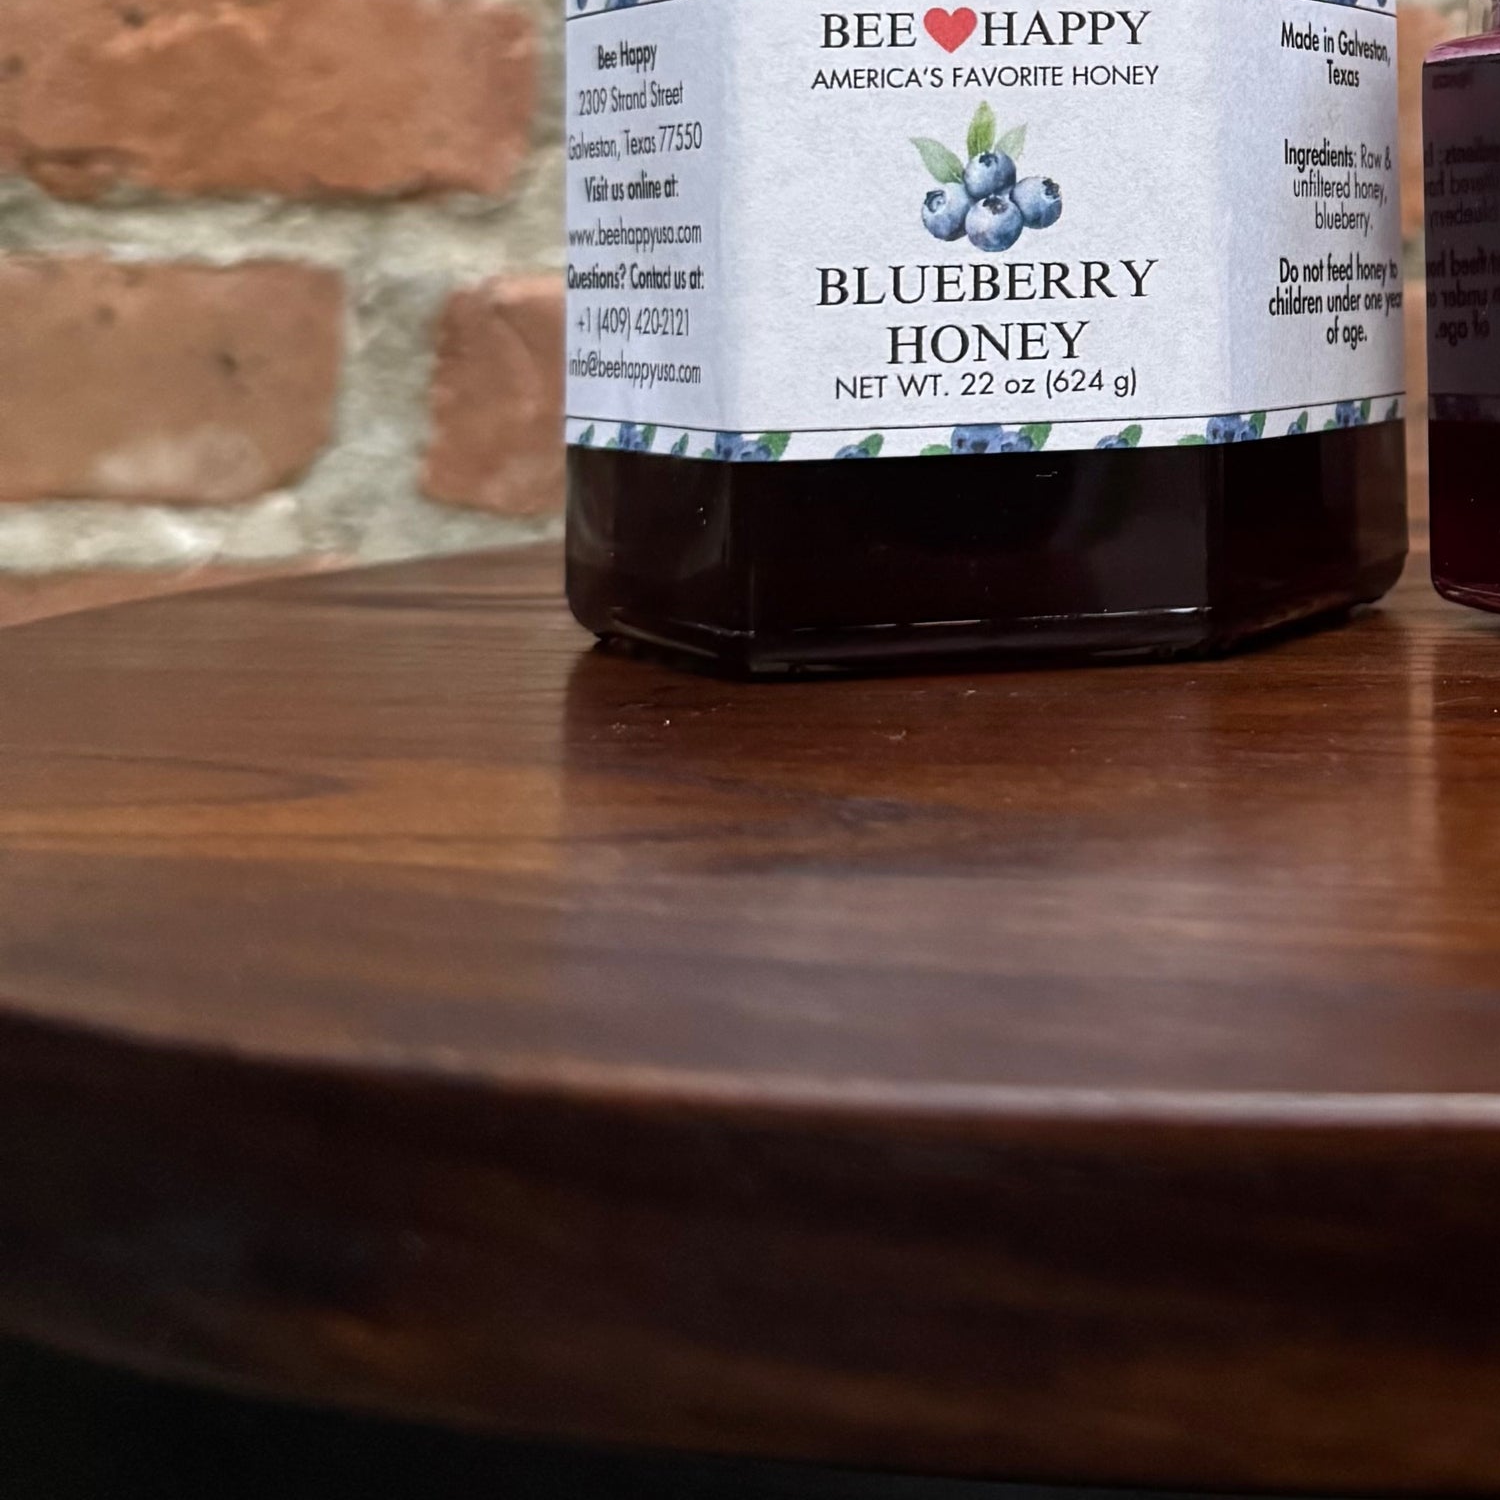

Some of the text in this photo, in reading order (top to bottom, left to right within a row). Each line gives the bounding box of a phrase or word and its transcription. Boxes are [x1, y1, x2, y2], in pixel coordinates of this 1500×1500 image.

[820, 10, 1152, 48] BEE HAPPY
[1281, 20, 1391, 67] Made in Galveston,
[597, 40, 657, 73] Bee Happy
[1326, 59, 1360, 88] Texas
[811, 65, 1159, 90] AMERICA'S FAVORITE HONEY
[579, 79, 683, 116] 2309 Strand Street
[568, 121, 702, 160] Galveston, Texas 77550
[1284, 137, 1357, 173] Ingredients:
[1361, 142, 1382, 169] Raw
[585, 169, 679, 202] Visit us online at:
[1293, 169, 1387, 208] unfiltered honey,
[569, 216, 702, 252] www.beehappyusa.com
[1315, 201, 1373, 237] blueberry.
[567, 262, 704, 290] Questions? Contact us at:
[816, 259, 1159, 306] BLUEBERRY
[1280, 257, 1298, 283] Do
[1303, 259, 1324, 282] not
[1327, 252, 1353, 281] feed
[1357, 252, 1387, 287] honey
[1389, 258, 1398, 279] to
[1269, 285, 1322, 316] children
[1327, 283, 1361, 312] under
[1364, 292, 1382, 310] one
[1385, 292, 1403, 317] yea
[577, 307, 689, 342] +1 (409) 420-2121
[1327, 315, 1367, 350] of age.
[887, 321, 1090, 365] HONEY
[569, 348, 702, 389] info@beehappyusa.com
[835, 367, 1137, 399] NET WT. 22 oz (624 g)
